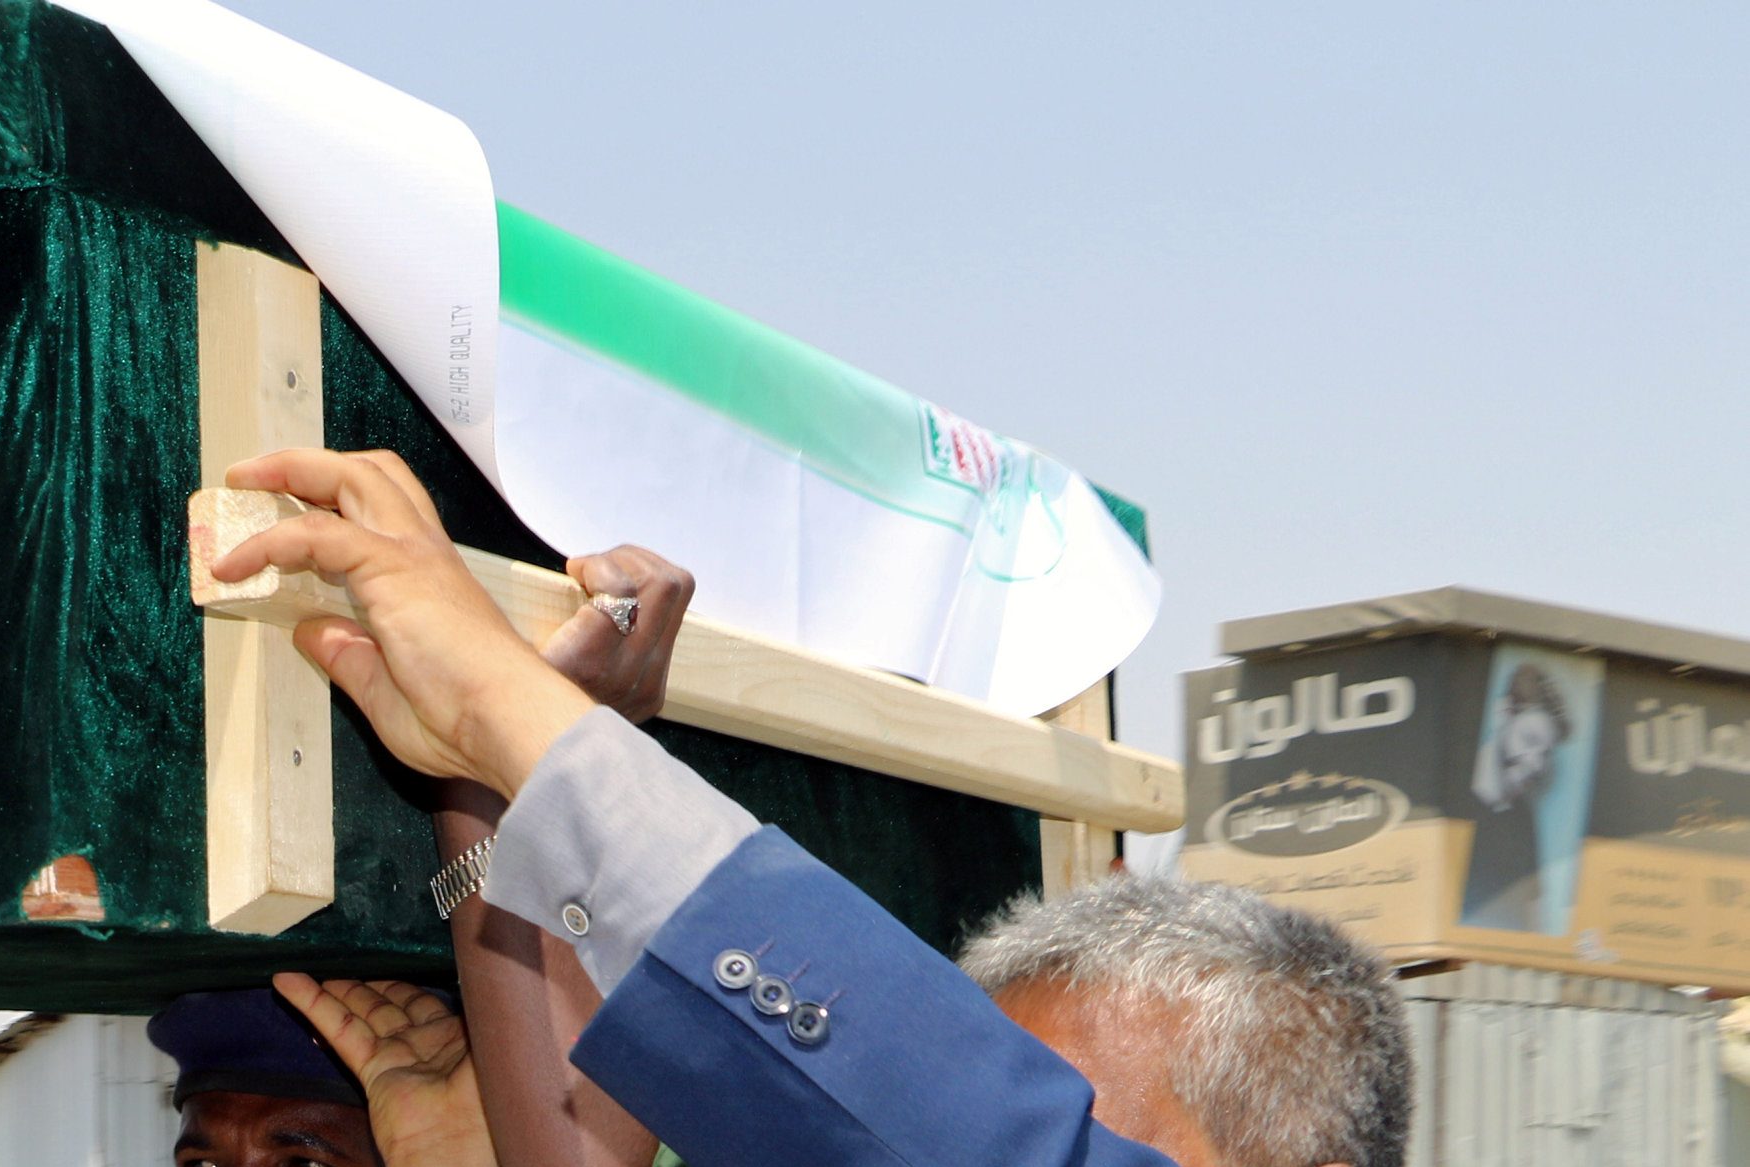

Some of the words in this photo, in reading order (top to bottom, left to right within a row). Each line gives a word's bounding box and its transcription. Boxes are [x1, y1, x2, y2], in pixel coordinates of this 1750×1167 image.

[450, 304, 473, 361] QUALITY
[449, 366, 470, 395] HIGH
[1198, 672, 1416, 765] صالون
